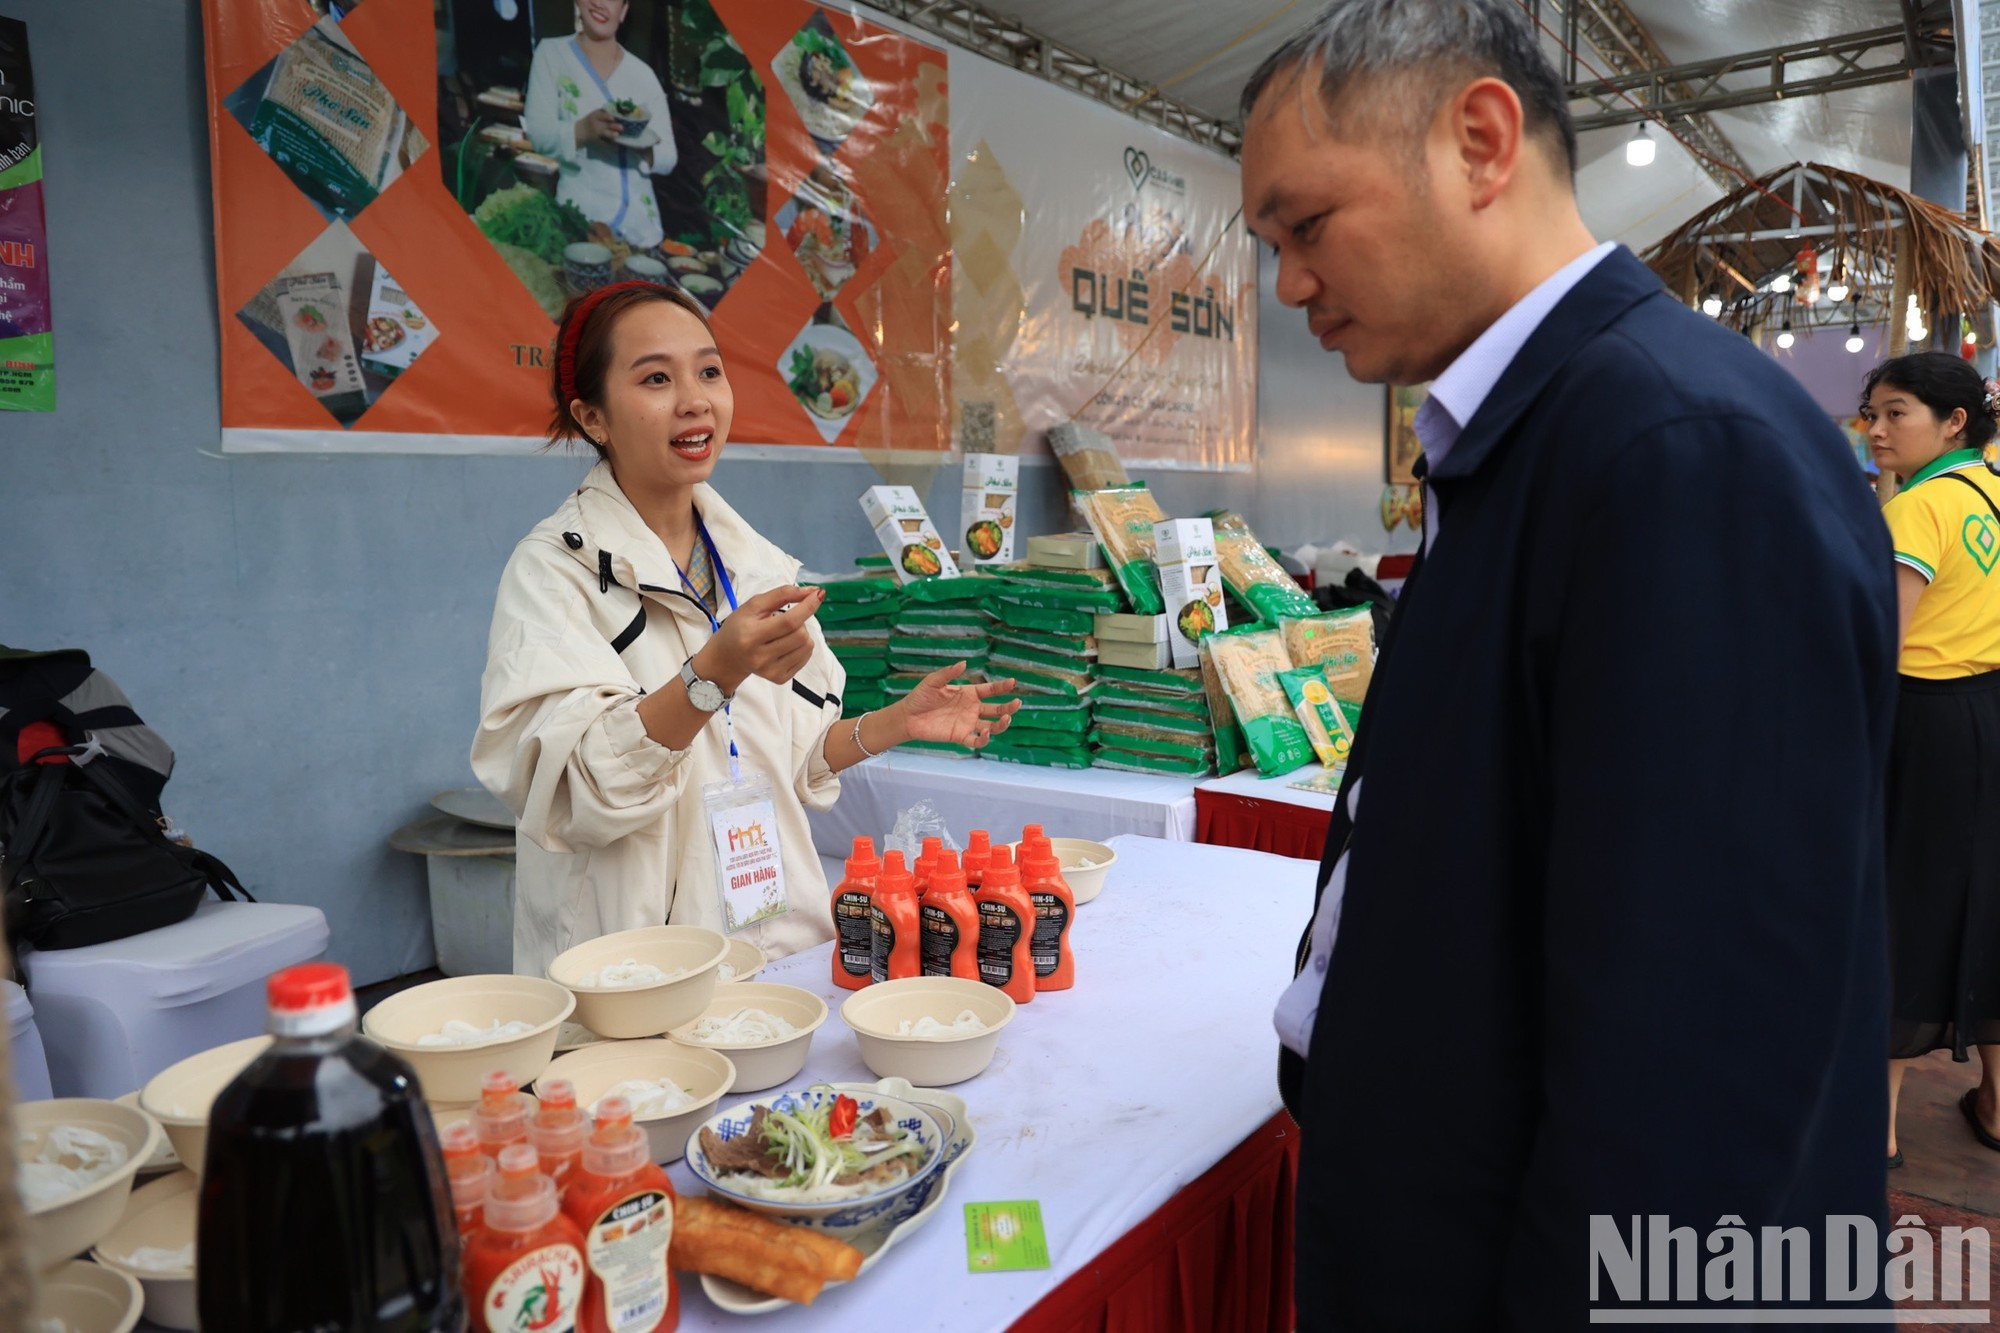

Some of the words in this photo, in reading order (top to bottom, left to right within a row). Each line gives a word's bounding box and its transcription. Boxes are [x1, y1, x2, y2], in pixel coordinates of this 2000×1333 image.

[1072, 260, 1154, 326] QUẾ
[731, 872, 752, 890] GIAN
[843, 893, 869, 904] CHIN-SU
[923, 906, 945, 919] CHIN-SU
[980, 902, 1007, 913] CHIN-SU
[612, 1192, 655, 1220] CHIN-SU
